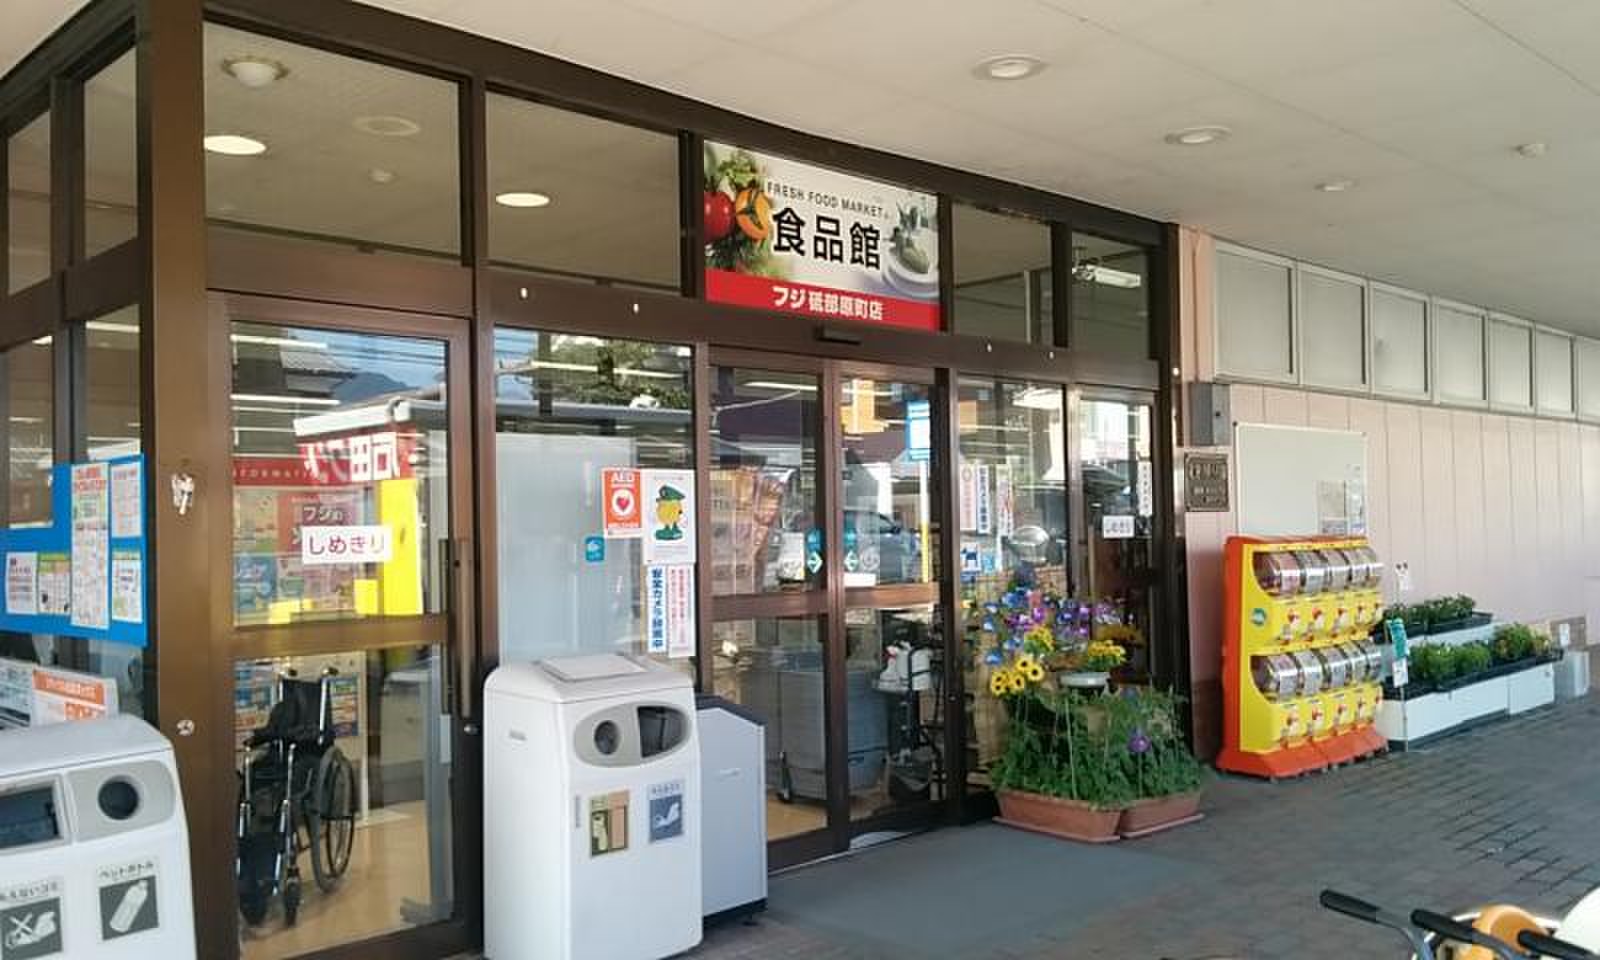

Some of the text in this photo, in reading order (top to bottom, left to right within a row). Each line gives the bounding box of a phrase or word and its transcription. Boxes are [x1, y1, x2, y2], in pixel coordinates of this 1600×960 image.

[767, 181, 884, 218] FRESH FOOD MARKET
[773, 207, 881, 271] 食品館
[308, 534, 386, 557] しめきり
